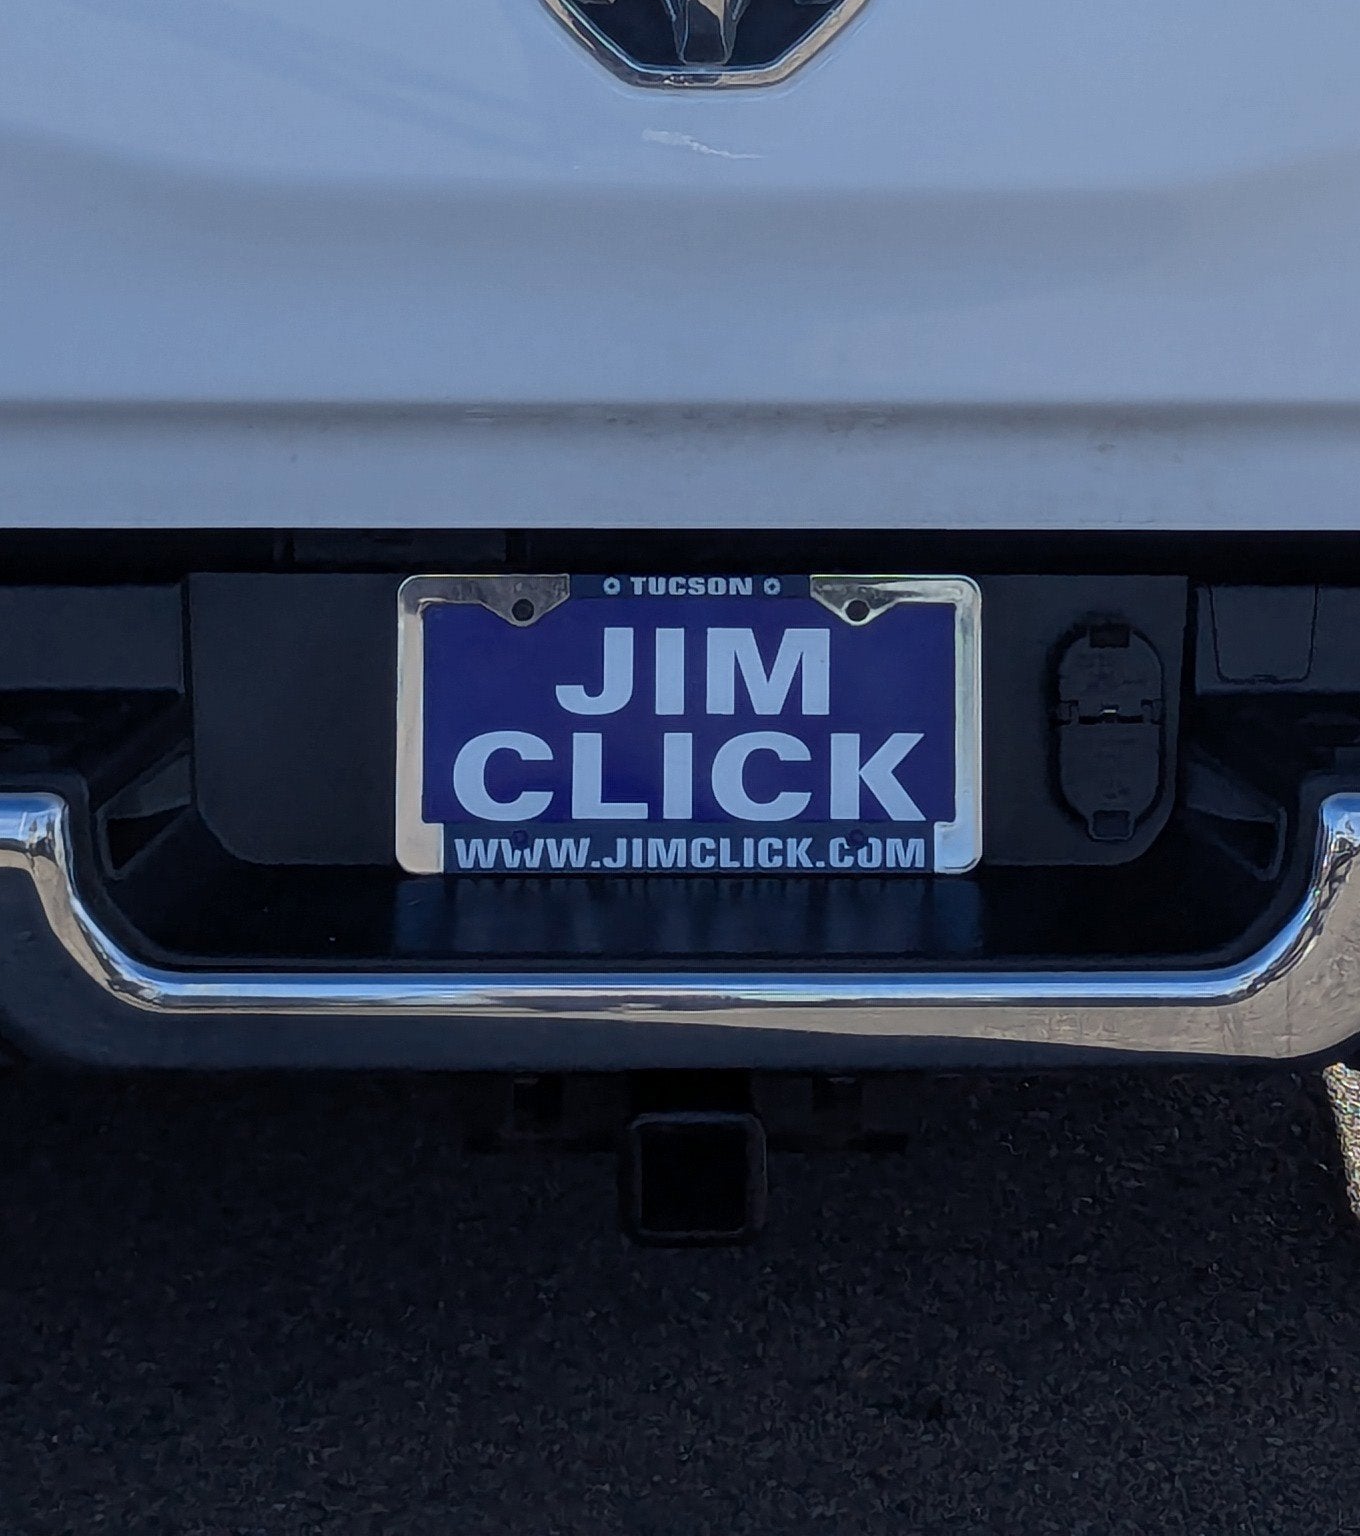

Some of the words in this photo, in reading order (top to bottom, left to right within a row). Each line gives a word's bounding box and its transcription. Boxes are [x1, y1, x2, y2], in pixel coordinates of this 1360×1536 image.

[630, 576, 753, 596] TUCSON
[555, 627, 830, 716] JIM
[452, 730, 927, 822] CLICK
